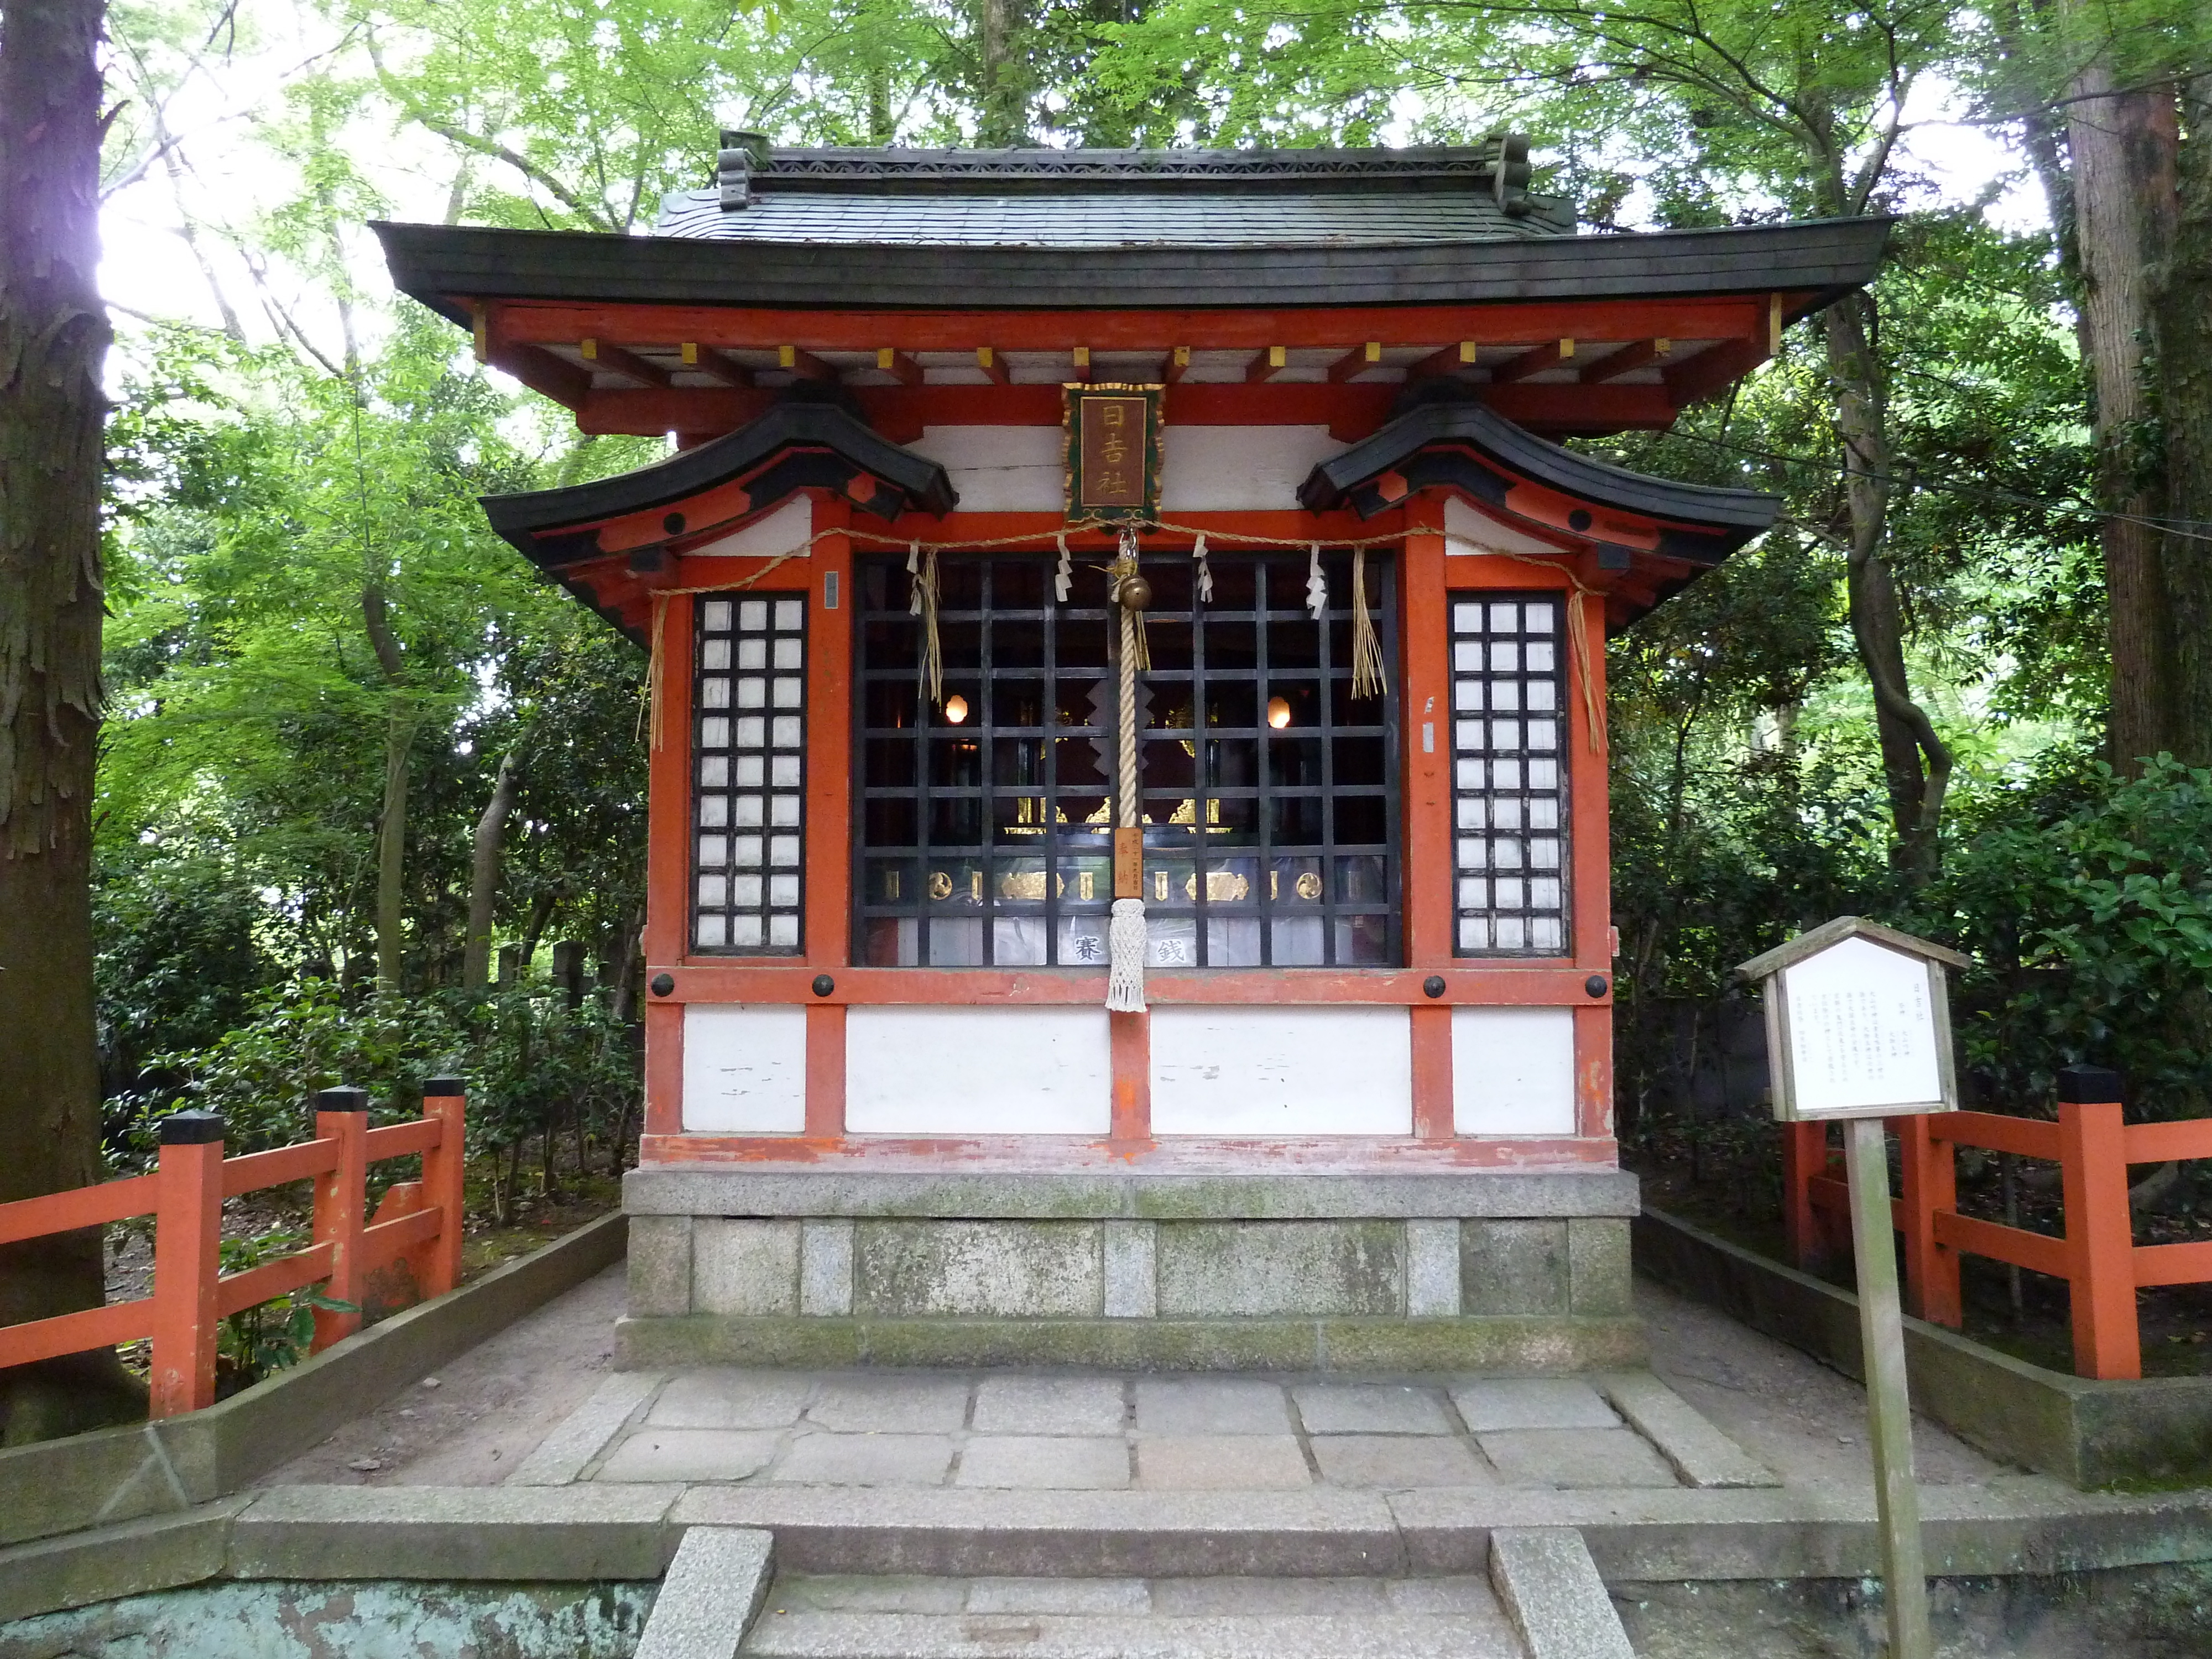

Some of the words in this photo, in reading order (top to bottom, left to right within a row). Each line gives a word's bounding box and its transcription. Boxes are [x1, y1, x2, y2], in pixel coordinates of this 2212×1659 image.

[1096, 405, 1128, 495] 日吉社
[1118, 842, 1129, 885] 奉納
[1076, 936, 1100, 961] 賽
[1157, 940, 1185, 962] 銭
